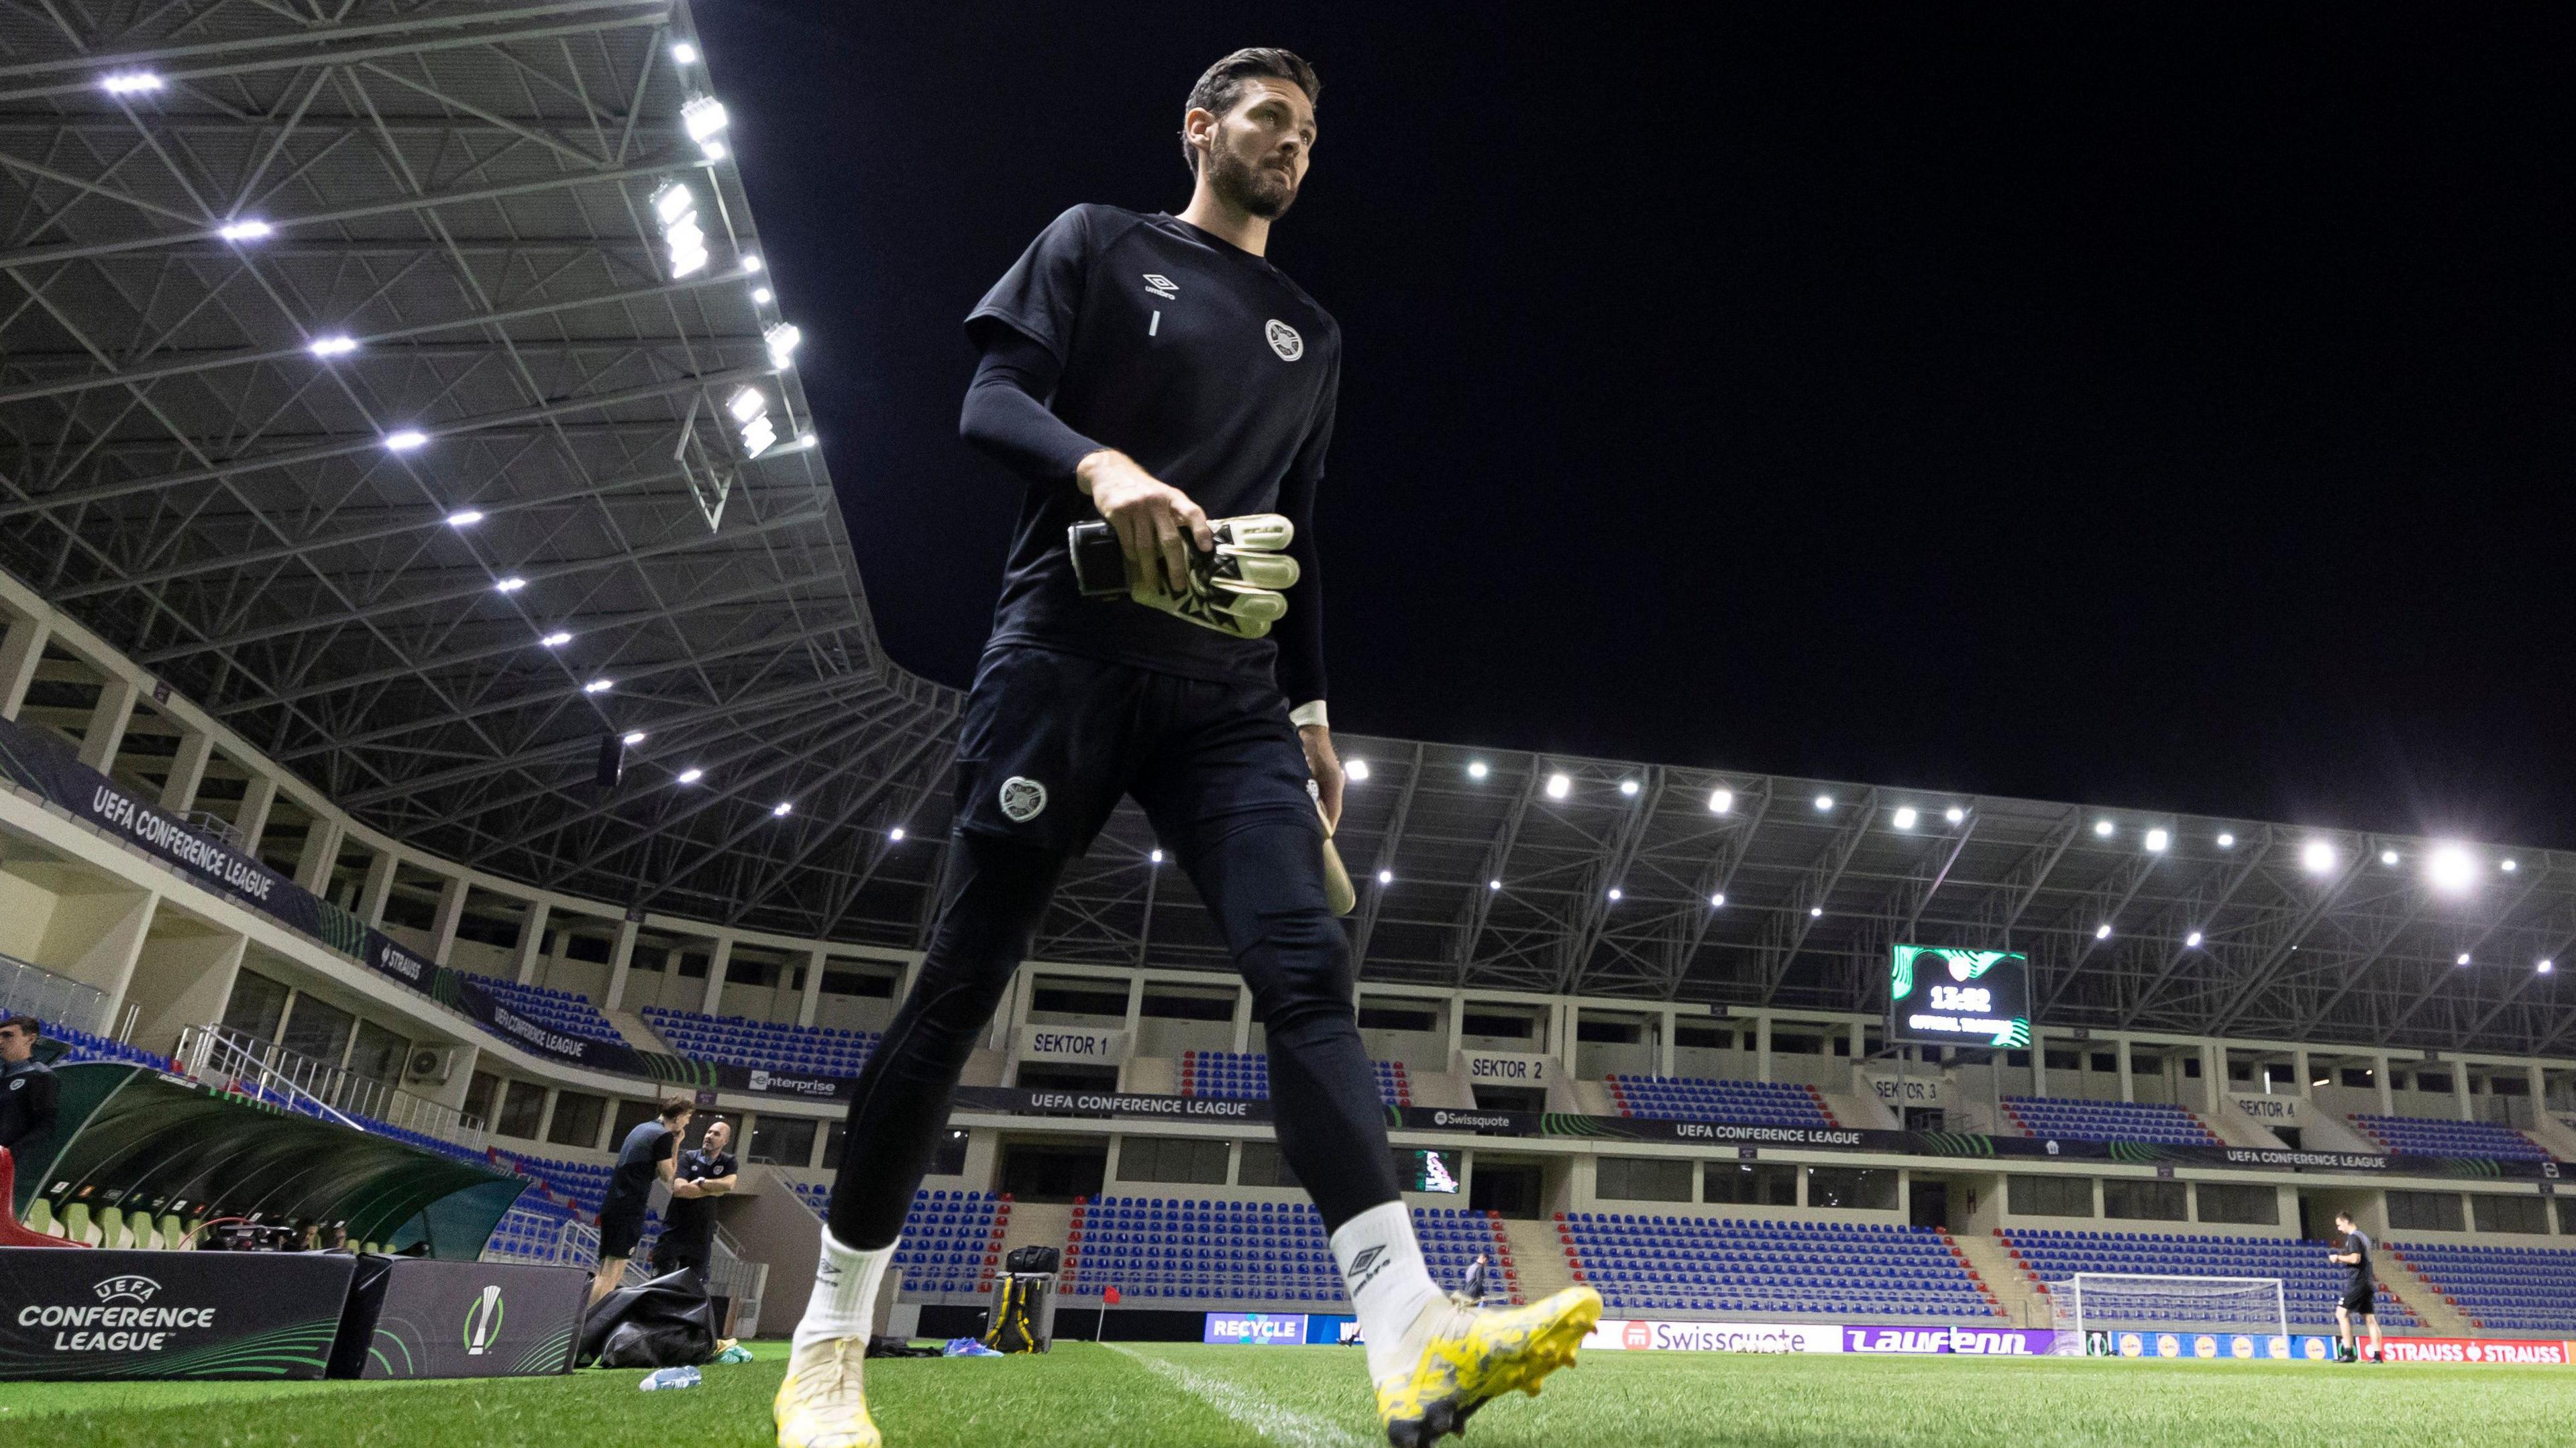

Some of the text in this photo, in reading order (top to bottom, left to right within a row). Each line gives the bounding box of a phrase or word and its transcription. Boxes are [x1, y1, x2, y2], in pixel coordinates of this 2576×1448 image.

[1145, 285, 1175, 300] umbro
[93, 785, 272, 901] UEFA CONFERENCE LEAGUE
[388, 950, 421, 980] STRAUSS
[545, 1033, 584, 1057] LEAGUE
[1034, 1034, 1108, 1055] SEKTOR 1
[1472, 1058, 1542, 1079] SEKTOR 2
[751, 1074, 835, 1091] enterprise
[1876, 1081, 1937, 1100] SEKOR 3
[1031, 1094, 1246, 1116] UEFA CONFERENCE LEAGUE
[2240, 1100, 2294, 1117] SEKTOR 4
[1448, 1113, 1509, 1128] Swissquote
[1677, 1124, 1860, 1145] UEFA CONFERENCE LEAGUE
[2226, 1150, 2386, 1168] UEFA CONFERENCE LEAGUE
[95, 1279, 156, 1300] UEFA
[17, 1305, 216, 1328] CONFERENCE
[1214, 1321, 1295, 1337] RECYCLE
[54, 1331, 166, 1351] LEAGUE
[2383, 1343, 2561, 1363] STRAUSS STRAUSS
